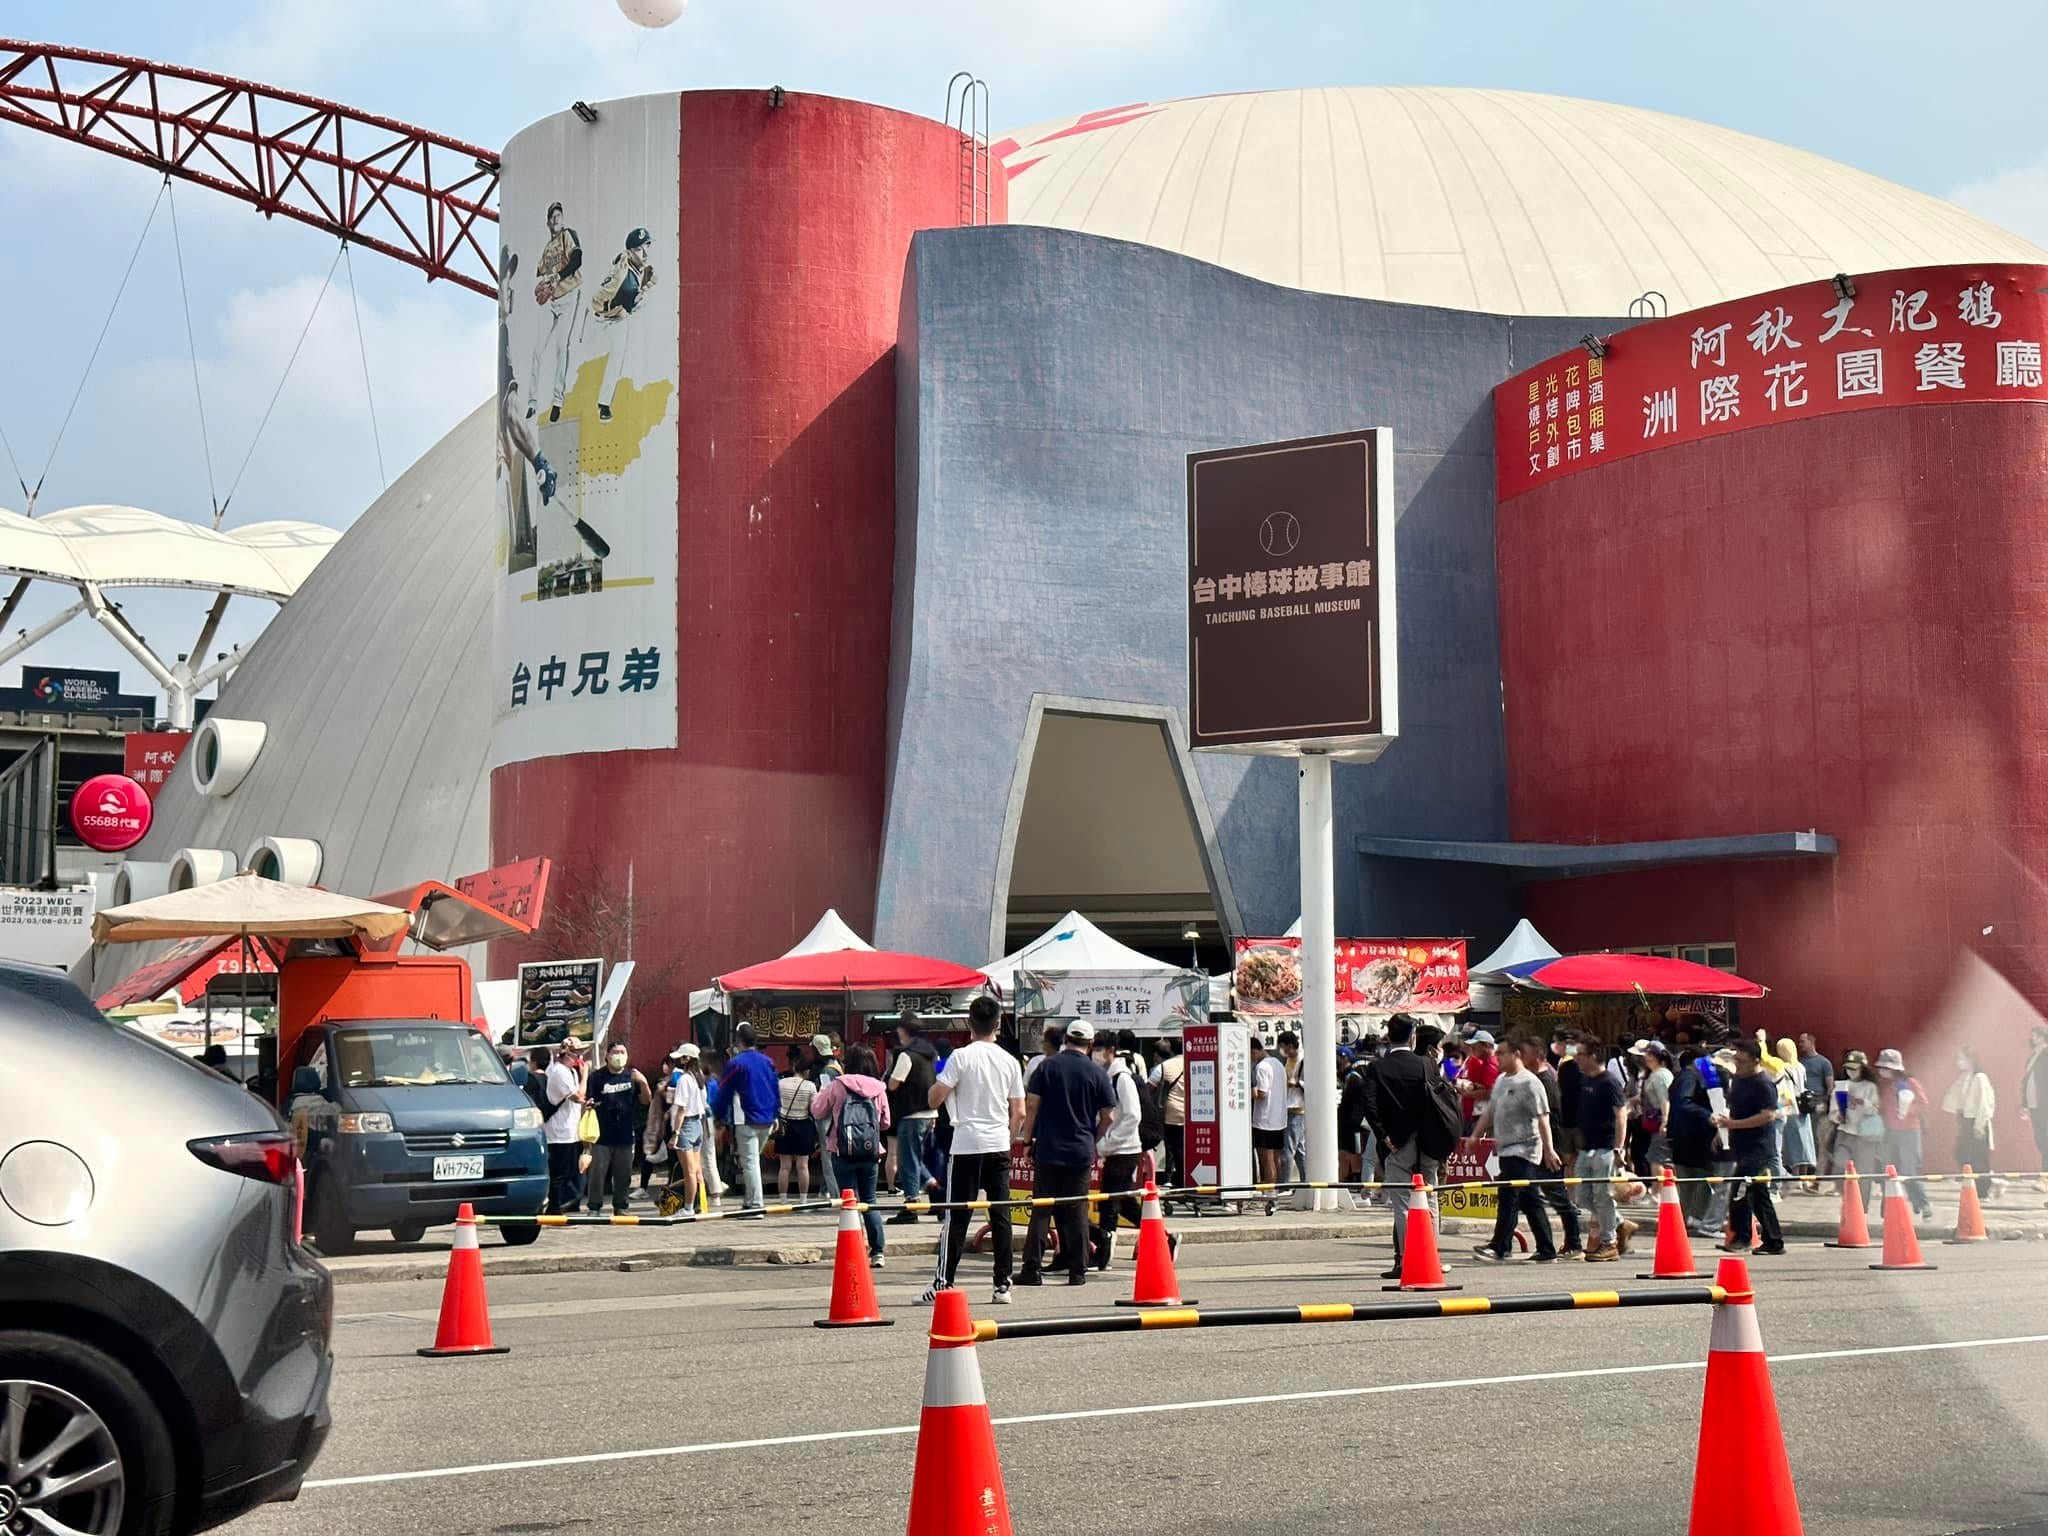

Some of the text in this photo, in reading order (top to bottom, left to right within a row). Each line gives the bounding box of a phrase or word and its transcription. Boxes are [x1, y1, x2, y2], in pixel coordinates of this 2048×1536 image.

[1690, 280, 2002, 369] 阿秋大肥鵝
[1642, 339, 2043, 438] 洲際花園餐廳
[1193, 559, 1371, 604] 台中棒球故事館
[1205, 598, 1361, 625] TAICHUNG BASEBALL MUSEUM
[64, 678, 97, 687] WORLD
[511, 646, 661, 708] 台中兄弟
[64, 685, 109, 695] BASEBALL
[64, 691, 102, 700] CLASSIC
[14, 896, 73, 905] 2023 WBC
[1075, 998, 1152, 1015] 老楊紅茶
[435, 1161, 483, 1177] AVH-7962
